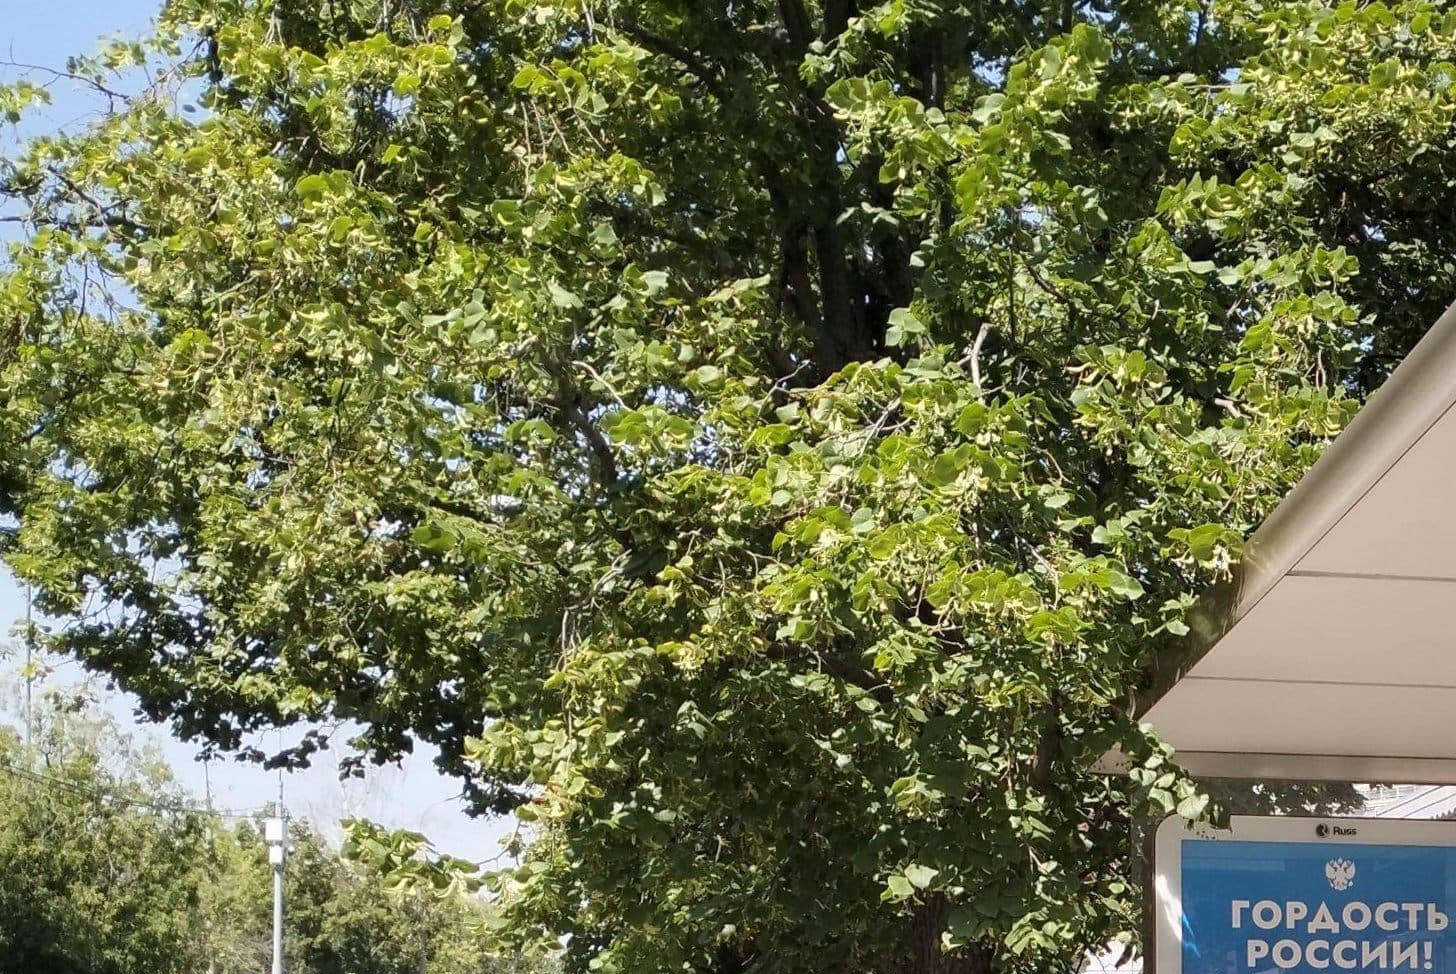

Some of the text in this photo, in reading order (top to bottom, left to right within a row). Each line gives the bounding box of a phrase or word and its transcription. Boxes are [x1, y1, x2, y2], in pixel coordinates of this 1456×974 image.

[1333, 826, 1357, 836] Russ
[1231, 899, 1449, 934] ГОРДОСТЬ
[1246, 938, 1433, 970] РОССИИ!
